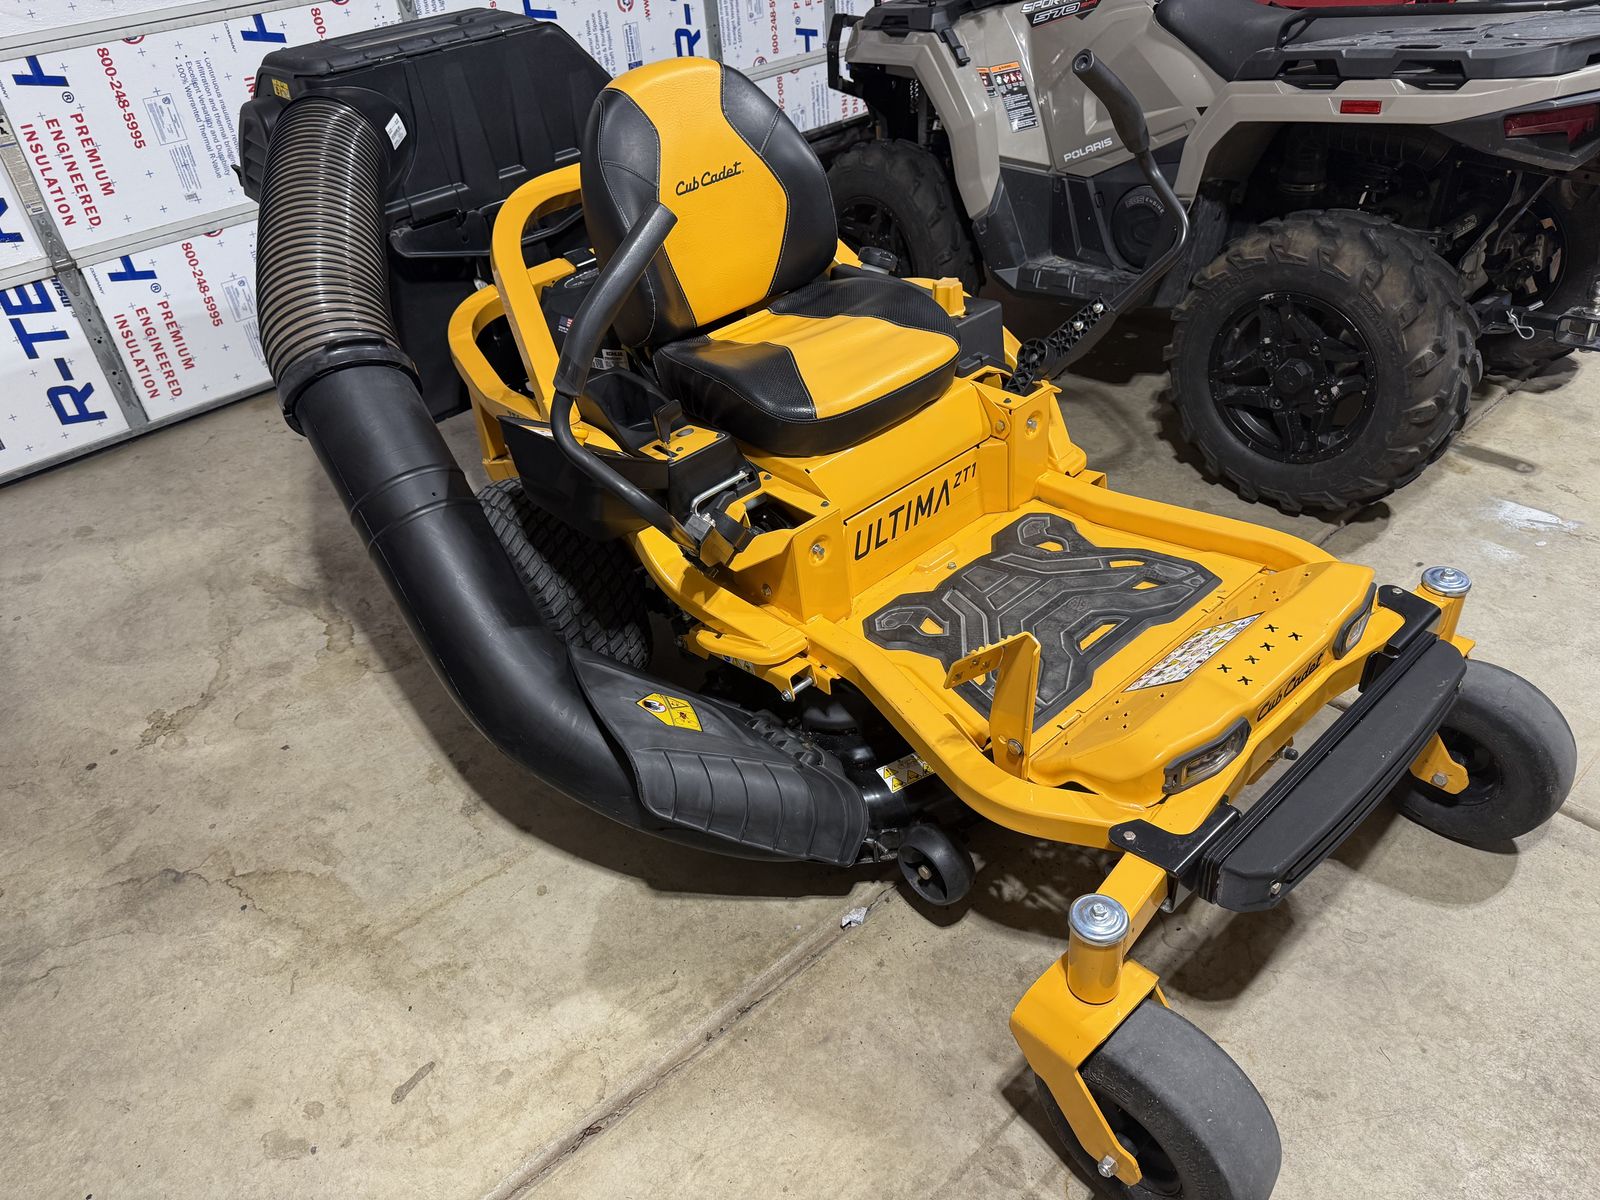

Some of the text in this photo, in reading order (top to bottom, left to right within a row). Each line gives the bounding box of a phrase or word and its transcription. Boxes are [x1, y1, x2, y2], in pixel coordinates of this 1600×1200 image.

[1033, 2, 1080, 24] 570
[97, 47, 146, 150] 800-248-5995
[175, 62, 188, 85] 100%
[183, 84, 203, 123] Warranted
[197, 123, 213, 152] Thermal
[184, 59, 232, 176] Excellent Versatility and Durability
[193, 58, 214, 97] infiltration
[207, 96, 218, 112] and
[70, 112, 115, 197] PREMIUM
[212, 112, 229, 140] thermal
[1063, 137, 1113, 163] POLARIS
[20, 123, 77, 227] INSULATION
[45, 118, 102, 227] ENGINEERED
[675, 161, 742, 196] Cub Cadet
[181, 242, 223, 327] 800-248-5995
[113, 313, 161, 399] INSULATION
[135, 306, 183, 397] ENGINEERED
[157, 301, 195, 370] PREMIUM
[854, 462, 976, 561] ULTIMA ZT1
[1257, 688, 1283, 722] Cub
[1284, 651, 1326, 697] Cadet
